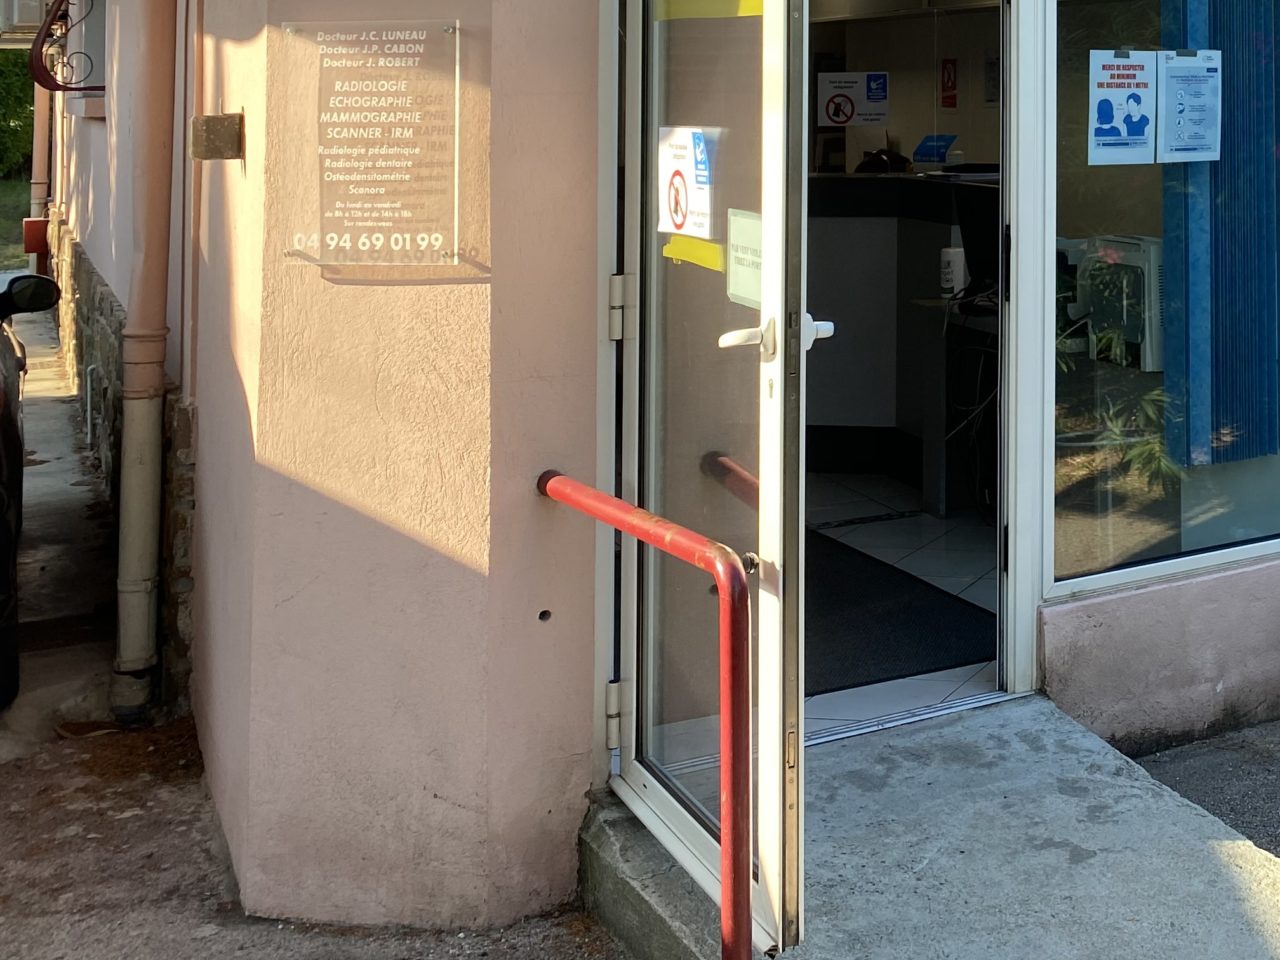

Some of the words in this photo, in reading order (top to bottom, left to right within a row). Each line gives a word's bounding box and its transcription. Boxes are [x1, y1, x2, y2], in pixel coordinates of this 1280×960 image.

[317, 31, 358, 41] Docteur
[360, 31, 379, 41] J.C.
[382, 30, 427, 41] LUNEAU
[319, 44, 360, 54] Docteur
[362, 44, 381, 54] J.P.
[384, 43, 424, 54] CABON
[323, 58, 364, 68] Docteur
[366, 57, 376, 67] J.
[378, 57, 421, 67] ROBERT
[334, 81, 408, 92] RADIOLOGIE
[329, 96, 413, 108] ECHOGRAPHIE
[320, 111, 423, 123] MAMMOGRAPHIE
[326, 127, 382, 139] SCANNER
[391, 127, 414, 139] IRM
[318, 144, 366, 157] Radiologie
[368, 144, 421, 157] pédiatrique
[324, 158, 372, 170] Radiologie
[375, 158, 413, 168] dentaire
[324, 171, 411, 181] Ostéodensitométrie
[348, 184, 385, 195] Scanora
[293, 232, 320, 250] 04
[326, 233, 352, 250] 94
[358, 233, 384, 250] 69
[390, 233, 411, 250] 01
[416, 233, 443, 250] 99
